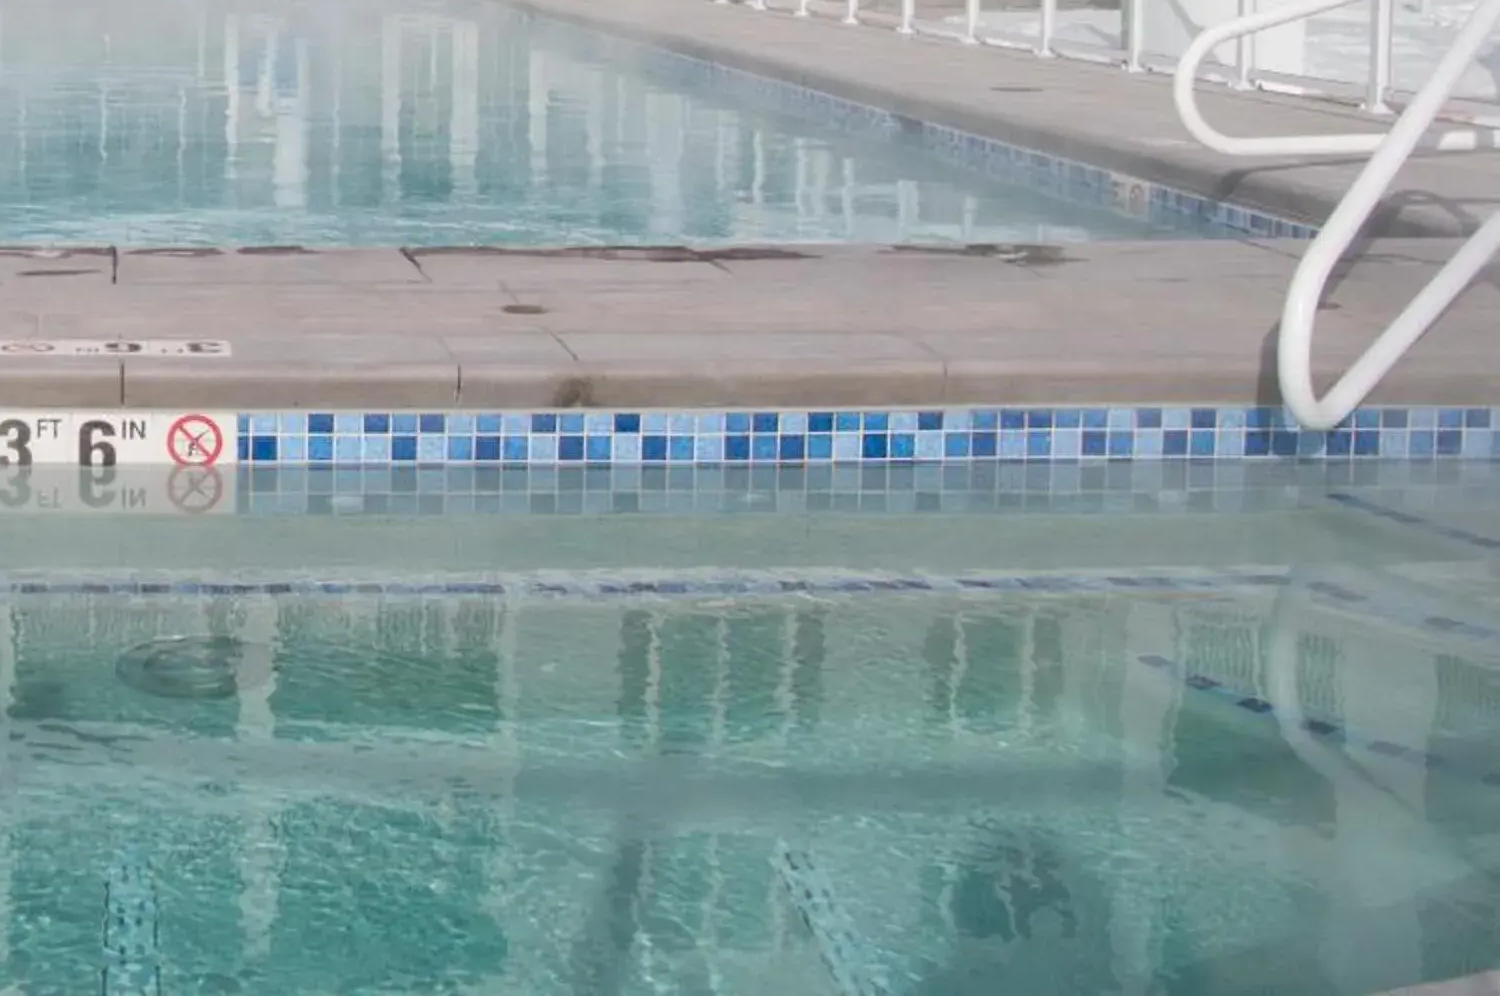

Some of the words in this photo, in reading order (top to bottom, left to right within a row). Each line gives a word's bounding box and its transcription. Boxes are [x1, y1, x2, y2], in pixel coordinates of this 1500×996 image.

[37, 419, 62, 438] FT
[79, 420, 116, 467] 6
[121, 420, 146, 439] IN
